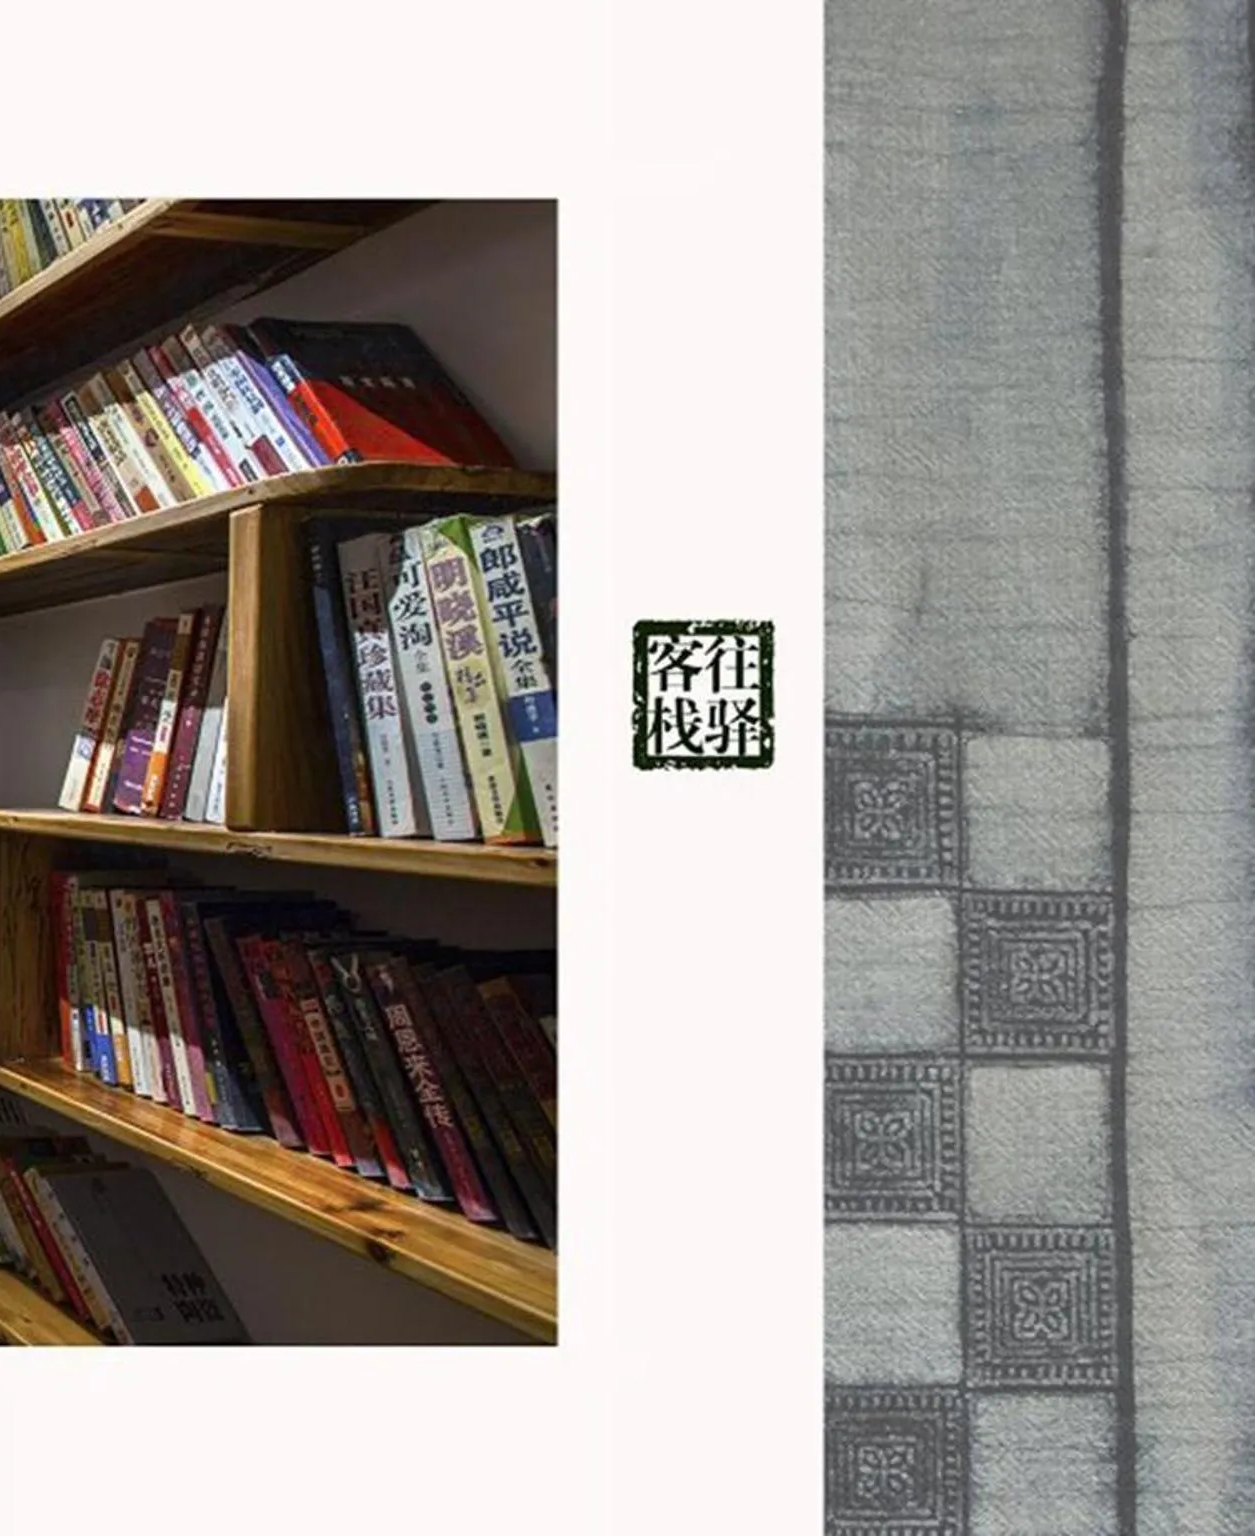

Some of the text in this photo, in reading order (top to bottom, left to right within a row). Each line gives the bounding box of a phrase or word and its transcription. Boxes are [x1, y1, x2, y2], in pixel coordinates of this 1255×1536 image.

[384, 1002, 454, 1129] 周恩来全传
